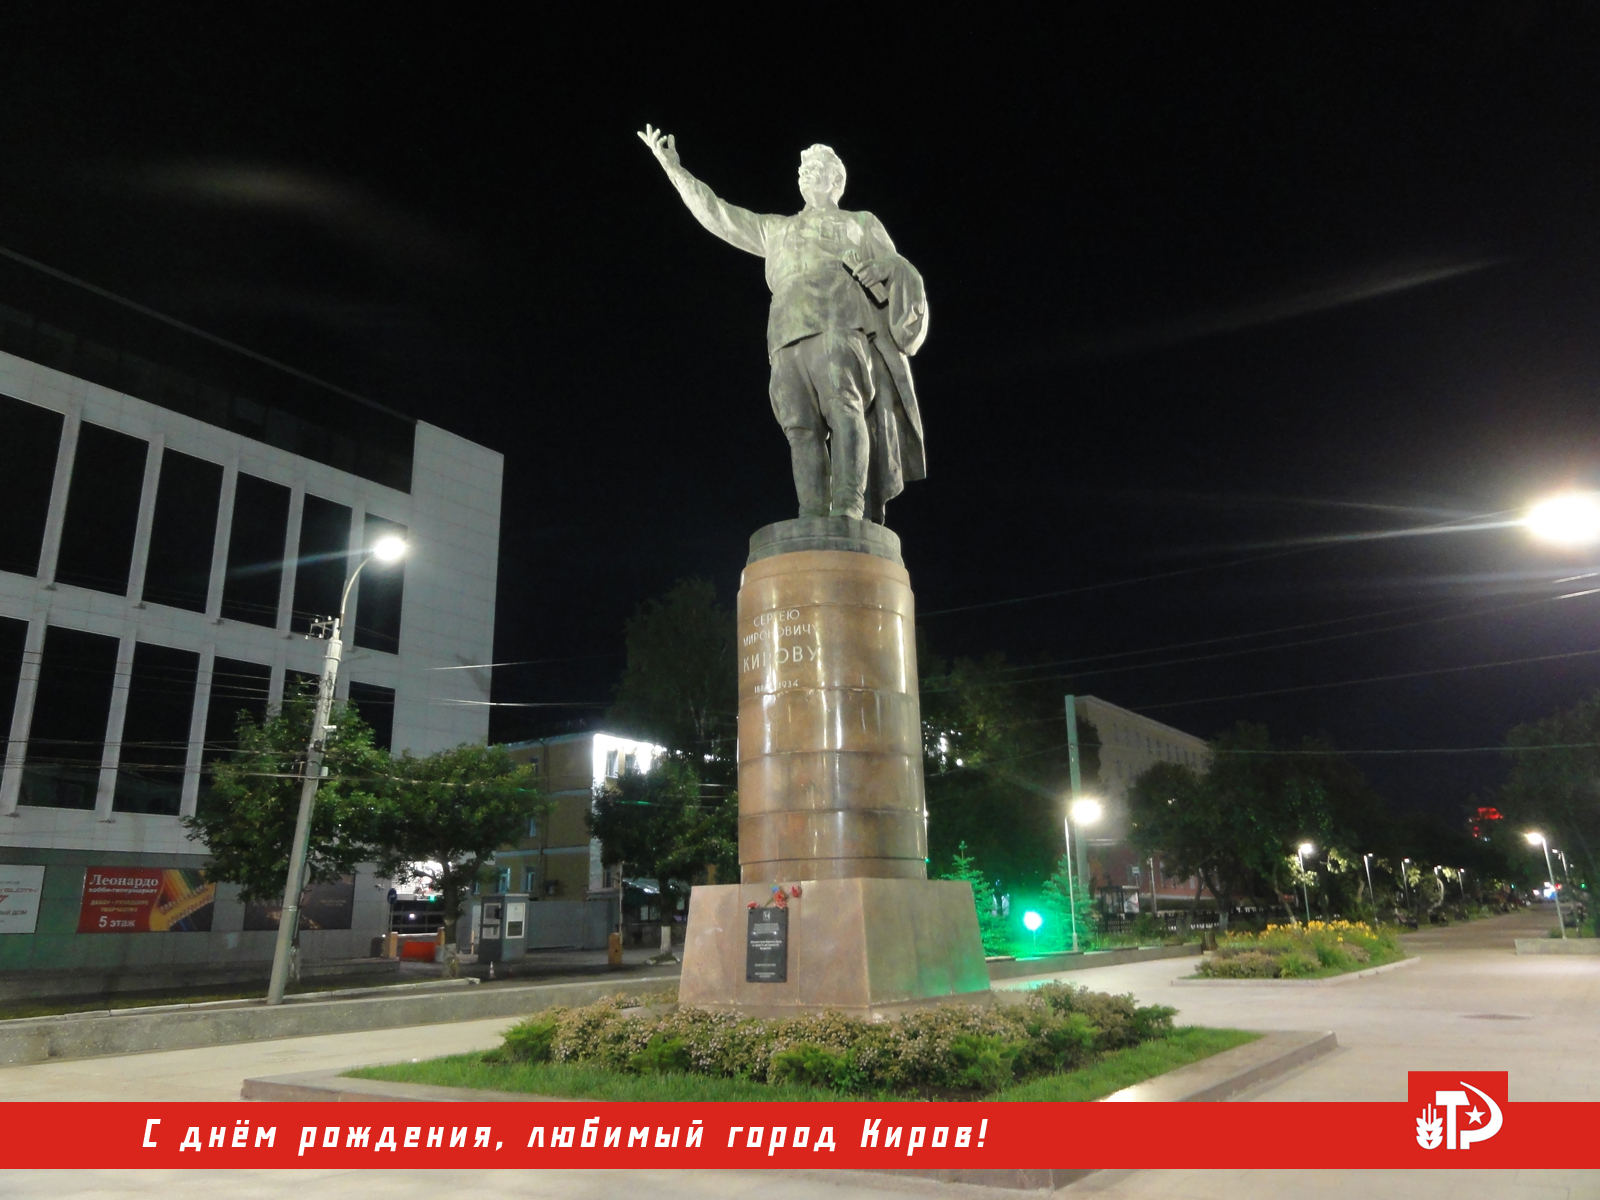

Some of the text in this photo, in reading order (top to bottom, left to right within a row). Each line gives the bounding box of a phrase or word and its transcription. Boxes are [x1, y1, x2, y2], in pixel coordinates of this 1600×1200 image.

[753, 609, 800, 627] СЕРЕЮ
[89, 874, 159, 888] Леонардо
[98, 915, 136, 928] 5 этаж
